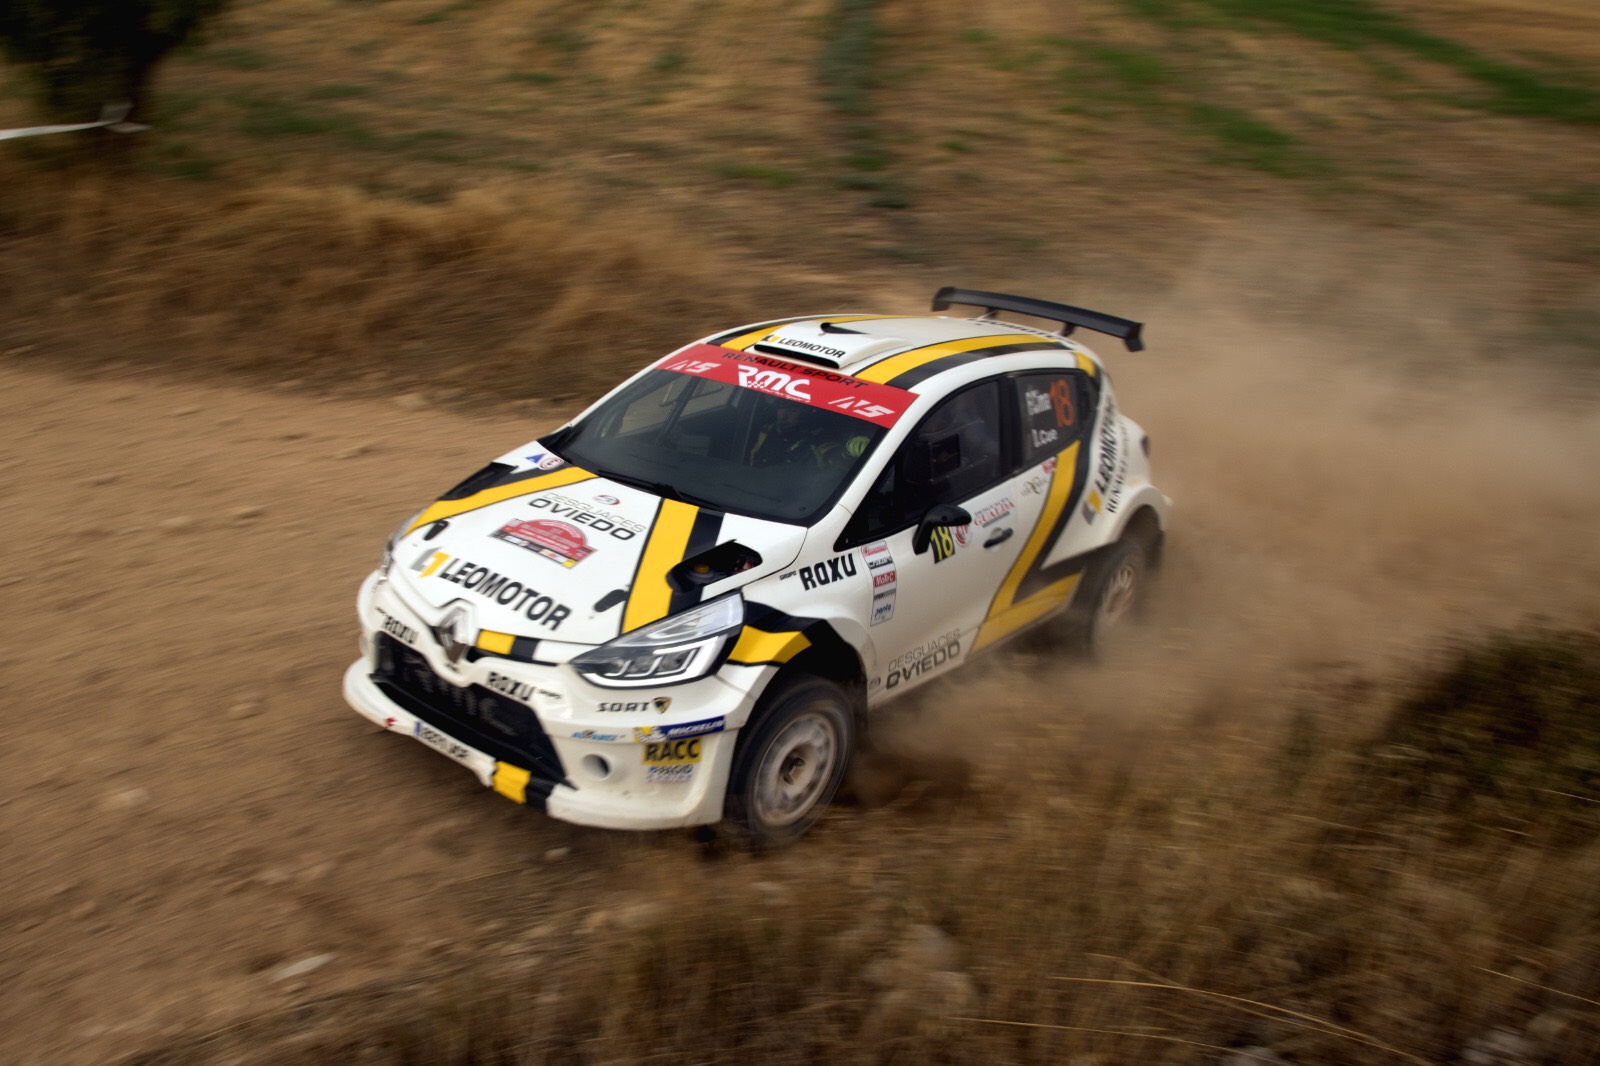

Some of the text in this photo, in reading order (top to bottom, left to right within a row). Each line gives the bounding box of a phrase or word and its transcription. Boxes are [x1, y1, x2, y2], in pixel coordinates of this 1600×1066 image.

[777, 337, 846, 359] LEOMOTOR
[722, 351, 868, 389] RENAULT SPORT
[1049, 379, 1074, 428] 18
[528, 497, 635, 541] OVIEDO
[541, 491, 647, 534] DESGUACES
[931, 525, 954, 561] 18
[799, 553, 857, 591] ROXU
[438, 557, 573, 631] LEOMOTOR
[885, 639, 962, 690] OVIEDO
[888, 628, 962, 672] DESGUACES
[487, 670, 536, 702] ROXU
[667, 719, 726, 739] MICHELIN
[644, 739, 700, 762] RACC
